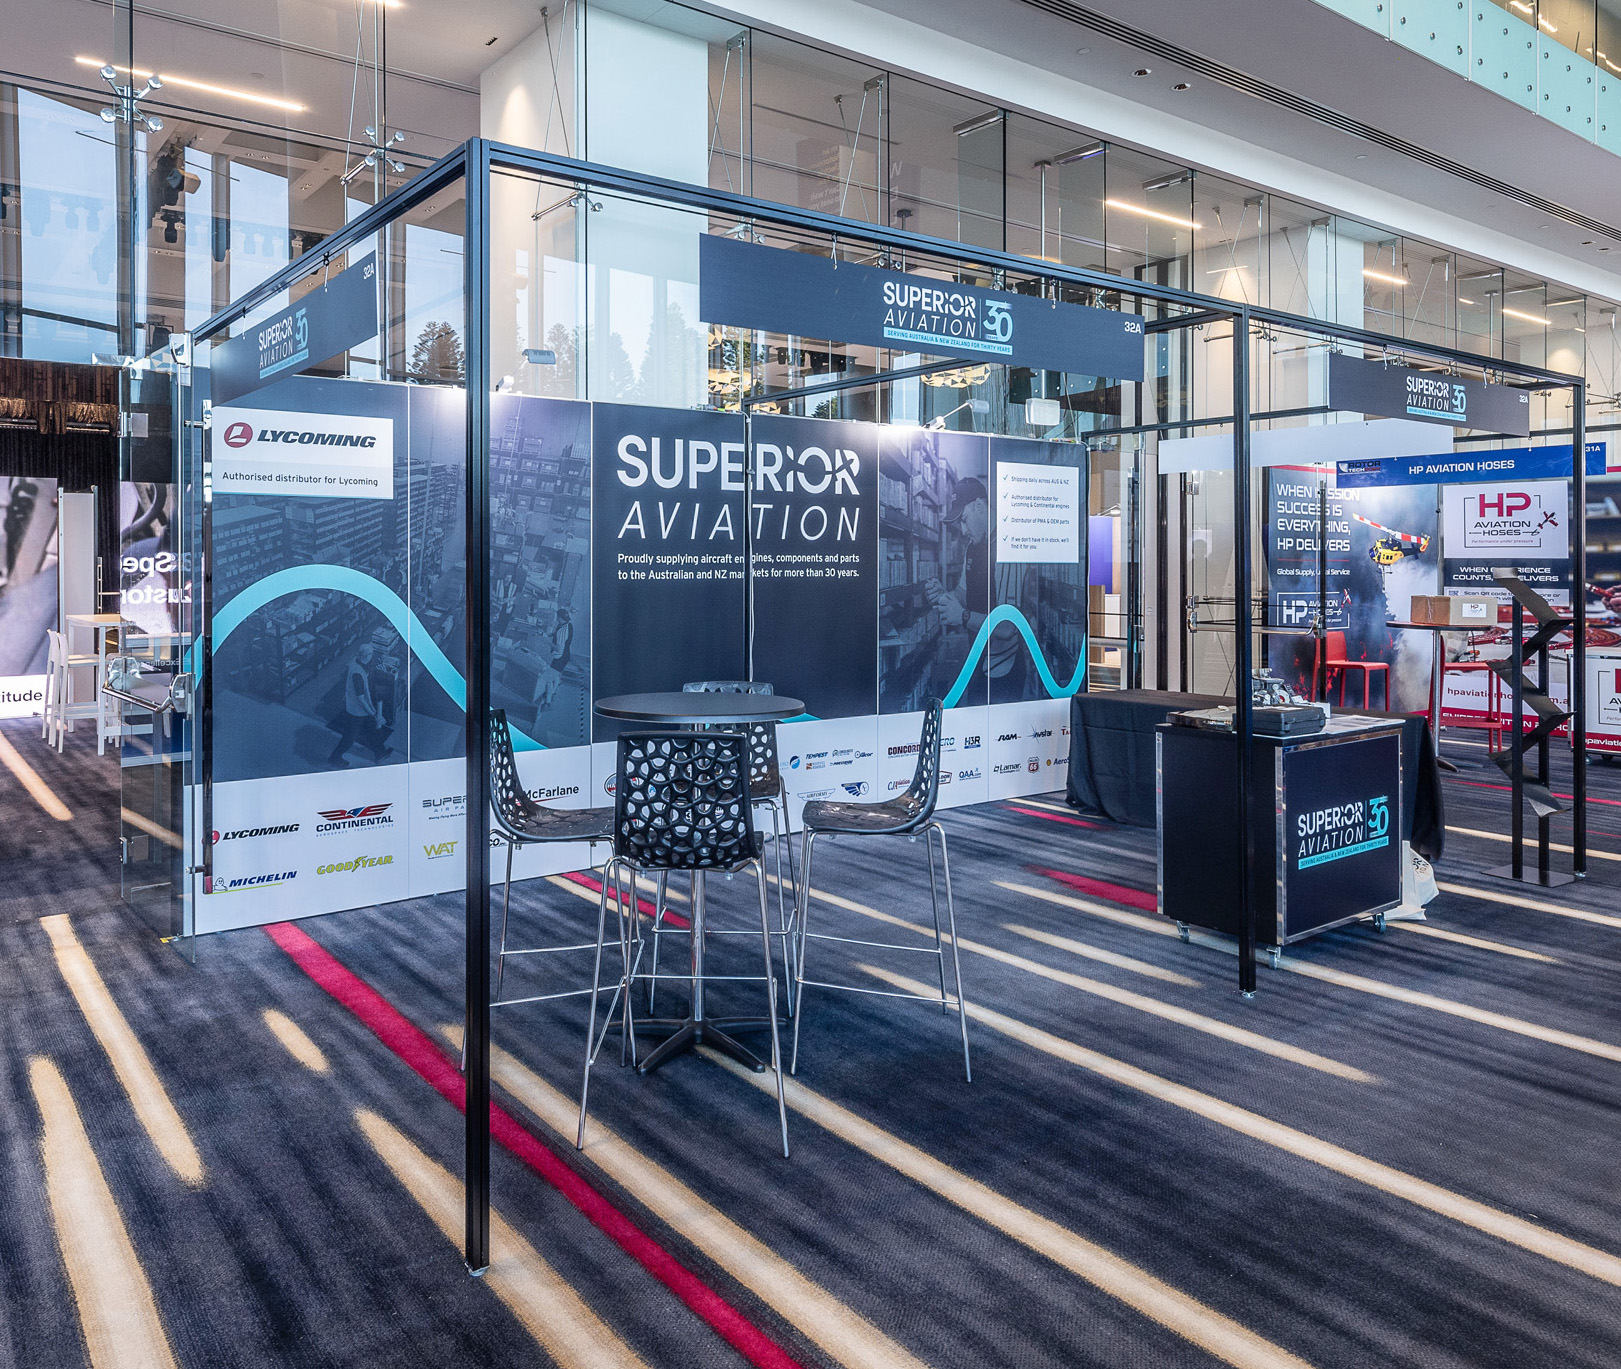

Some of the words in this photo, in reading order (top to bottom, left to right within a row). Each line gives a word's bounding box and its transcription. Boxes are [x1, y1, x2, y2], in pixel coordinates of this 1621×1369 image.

[363, 262, 375, 280] 32A
[883, 281, 976, 319] SUPERIOR
[295, 308, 309, 349] 30
[883, 308, 976, 338] AVIATION
[983, 299, 1013, 343] 30
[1124, 321, 1142, 334] 32A
[258, 315, 293, 352] SUPERIOR
[887, 329, 908, 338] SERVING
[909, 332, 934, 343] AUSTRALIA
[940, 337, 950, 345] NEW
[950, 339, 971, 347] ZEALAND
[981, 343, 996, 351] THIRTY
[997, 345, 1011, 353] YEARS
[259, 338, 293, 369] AVIATION
[1406, 375, 1449, 398] SUPERIOR
[1406, 393, 1449, 411] AVIATION
[1452, 384, 1467, 413] 30
[257, 429, 376, 448] LYCOMING
[617, 434, 860, 496] SUPERIOR
[1348, 460, 1380, 468] ROTOR
[1409, 465, 1424, 475] HP
[1426, 462, 1474, 474] AVIATION
[1477, 460, 1515, 470] HOSES
[222, 471, 272, 482] Authorised
[275, 474, 322, 484] distributor
[324, 476, 336, 484] for
[339, 476, 378, 488] Lycoming
[1277, 483, 1312, 498] WHEN
[1332, 504, 1343, 517] IS
[1479, 492, 1532, 518] HP
[617, 500, 860, 541] AVIATION
[1474, 520, 1531, 528] AVIATION
[1277, 537, 1294, 550] HP
[617, 553, 654, 565] Proudly
[656, 553, 699, 566] supplying
[700, 553, 733, 563] aircraft
[776, 553, 823, 564] components
[824, 553, 839, 563] and
[840, 554, 860, 564] parts
[617, 569, 628, 580] to
[630, 569, 646, 580] the
[648, 569, 694, 580] Australian
[696, 569, 712, 579] and
[714, 569, 728, 579] NZ
[771, 567, 782, 578] for
[784, 569, 805, 578] more
[806, 568, 824, 577] than
[825, 568, 836, 577] 30
[837, 568, 860, 579] years.
[1277, 568, 1295, 576] Global
[1295, 568, 1315, 577] Supply,
[1330, 568, 1350, 576] Service
[1452, 574, 1494, 582] COUNTS,
[1283, 600, 1308, 624] HP
[888, 744, 921, 755] CONCORD
[964, 736, 981, 746] H3R
[316, 815, 394, 832] CONTINENTAL
[1298, 801, 1363, 837] SUPERIOR
[1368, 796, 1389, 836] 30
[222, 823, 300, 841] LYCOMING
[423, 841, 459, 857] WAT
[1298, 825, 1363, 858] AVIATION
[316, 855, 394, 876] GOODYEAR
[229, 871, 298, 888] MICHELIN
